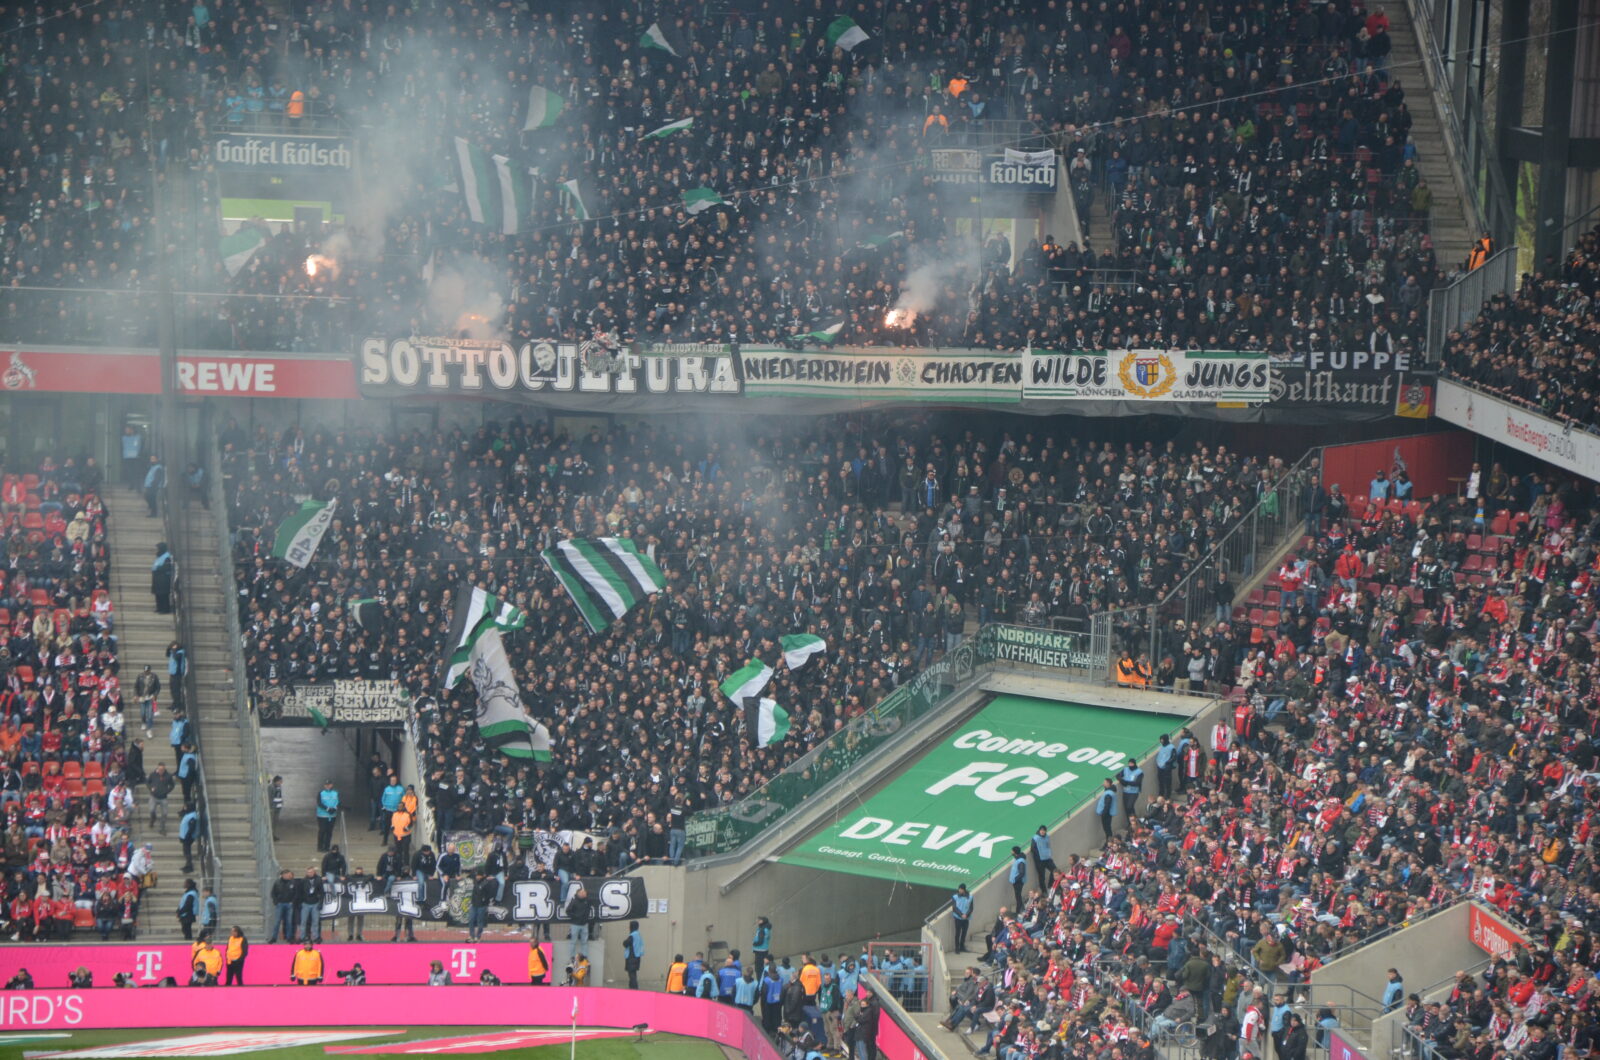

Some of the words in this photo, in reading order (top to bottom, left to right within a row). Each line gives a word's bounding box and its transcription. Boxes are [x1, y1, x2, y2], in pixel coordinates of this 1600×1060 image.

[216, 138, 278, 166] Gaffel
[744, 357, 891, 383] NIEDERRHEIN
[920, 361, 1022, 385] CHAOTEN
[1032, 357, 1108, 386] WILDE
[1185, 362, 1268, 388] JUNGS
[1310, 351, 1410, 371] FUPPE
[177, 362, 275, 391] REWE
[1269, 369, 1393, 405] Selfkant
[1173, 389, 1222, 399] GLADBACH
[997, 626, 1072, 649] NORDHARZ
[997, 642, 1068, 668] KYFFHÄUSER
[334, 694, 397, 708] SERVICE
[952, 729, 1068, 758] Come
[1066, 747, 1127, 771] on,
[924, 761, 1080, 807] FC!
[838, 816, 1014, 859] DEVK
[818, 845, 863, 860] Gesagt.
[868, 852, 907, 865] Getan.
[912, 858, 971, 875] Geholfen.
[136, 951, 162, 980] T
[452, 949, 476, 977] T
